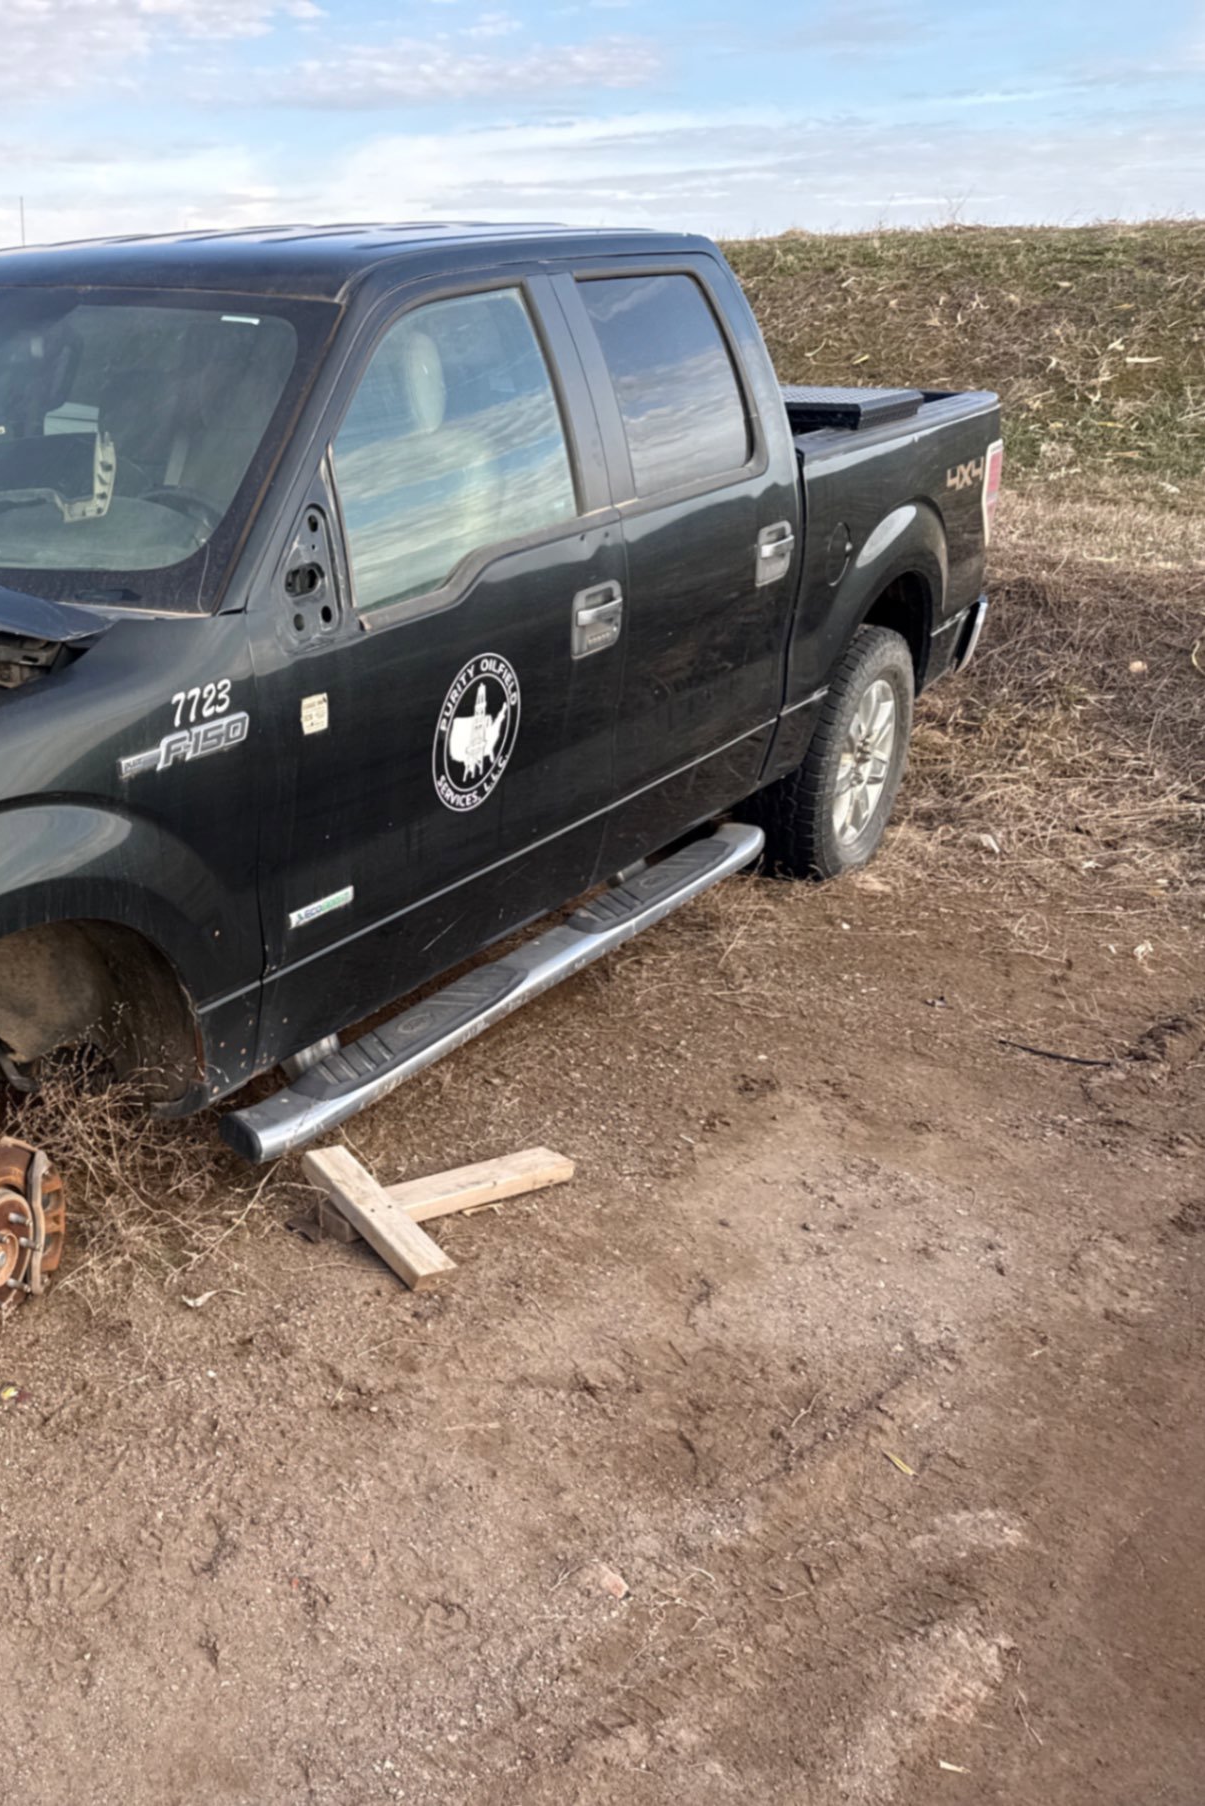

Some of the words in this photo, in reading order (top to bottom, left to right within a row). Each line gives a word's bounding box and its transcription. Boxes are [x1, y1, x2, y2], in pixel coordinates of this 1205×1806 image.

[171, 678, 232, 727] 7723
[439, 664, 475, 732] PURITY
[480, 657, 518, 706] OILFIELD
